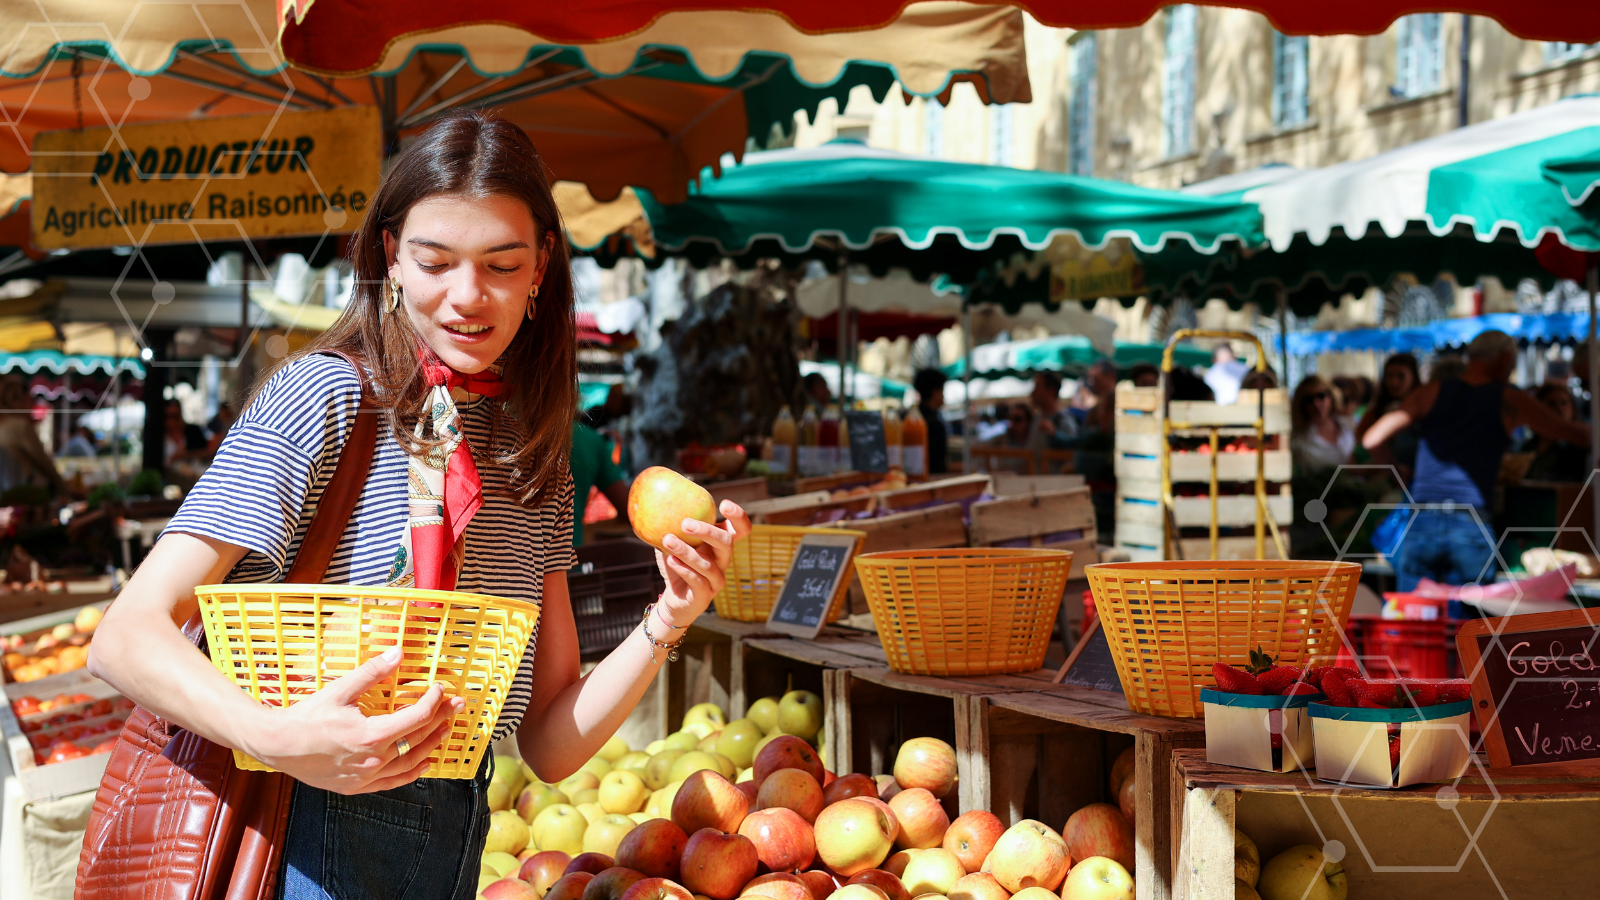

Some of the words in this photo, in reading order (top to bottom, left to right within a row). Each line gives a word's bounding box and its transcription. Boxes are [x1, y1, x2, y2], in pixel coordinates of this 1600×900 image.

[90, 135, 315, 186] PRODUCTEUR
[43, 200, 195, 236] Agriculture
[208, 185, 367, 220] Raisonnée
[1563, 680, 1600, 709] 2.
[1515, 722, 1600, 756] Vene
